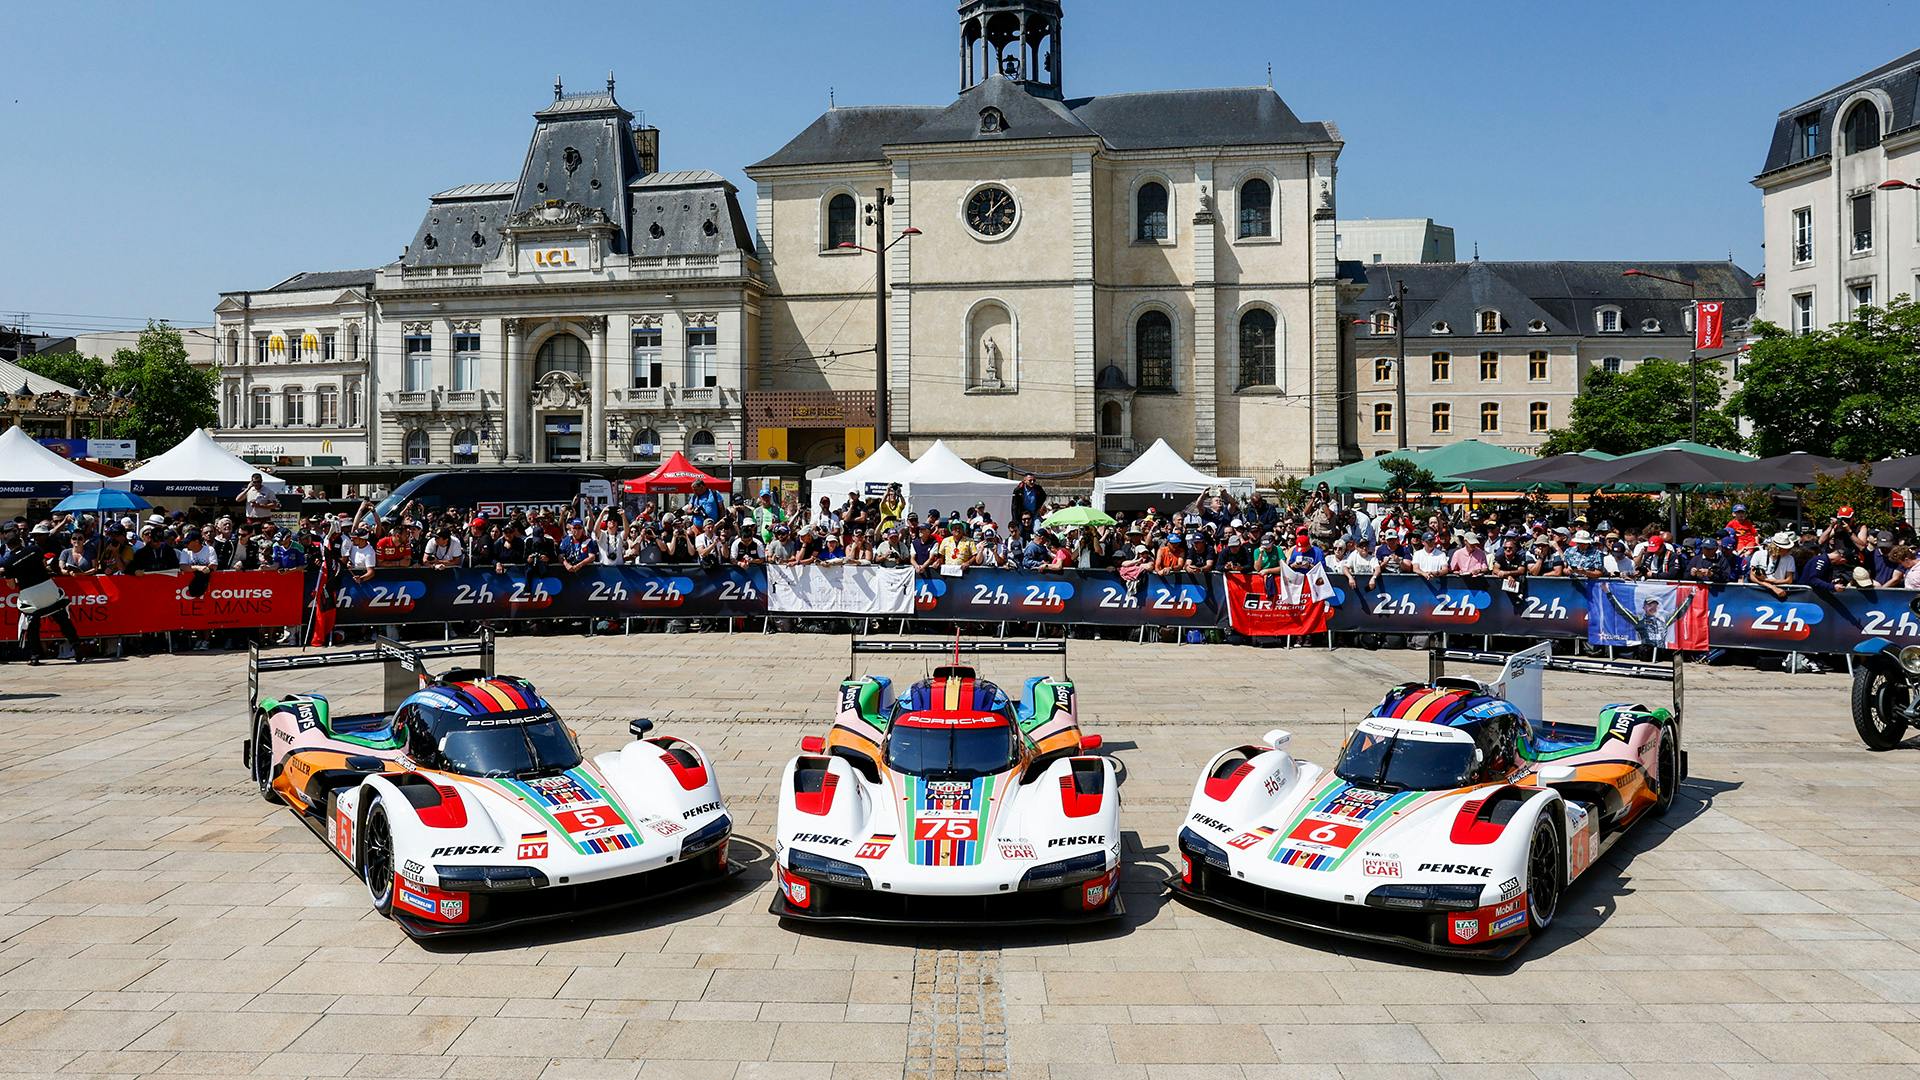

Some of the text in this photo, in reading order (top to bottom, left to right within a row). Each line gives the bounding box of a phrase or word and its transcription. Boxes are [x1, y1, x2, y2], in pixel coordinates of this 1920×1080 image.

[535, 248, 576, 267] LCL
[211, 587, 273, 599] course
[368, 586, 411, 608] 24h
[453, 584, 494, 605] 24h
[588, 581, 628, 601] 24h
[642, 581, 681, 601] 24h
[719, 580, 757, 600] 24h
[971, 584, 1009, 605] 24h
[1023, 585, 1061, 606] 24h
[1153, 588, 1193, 610] 24h
[1244, 600, 1272, 610] GR
[1275, 603, 1307, 611] Racing
[1373, 593, 1417, 615] 24h
[1432, 593, 1476, 616] 24h
[180, 599, 272, 617] LE MANS
[1521, 597, 1568, 619] 24h
[1752, 606, 1807, 631] 24h
[381, 644, 414, 664] PORSCHE
[1511, 650, 1546, 669] PORSCHE
[401, 661, 414, 672] 963
[1056, 686, 1069, 711] Ansys
[467, 712, 554, 726] PORSCHE
[907, 715, 996, 725] PORSCHE
[1610, 714, 1635, 740] Ansys
[274, 728, 295, 745] PENSKE
[1366, 722, 1454, 737] PORSCHE
[682, 801, 720, 820] PENSKE
[1334, 799, 1376, 809] Ansys
[573, 808, 605, 828] 5
[1192, 813, 1234, 834] PENSKE
[657, 823, 684, 835] CAR
[921, 819, 972, 838] 75
[1309, 824, 1338, 842] 6
[792, 833, 853, 846] PENSKE
[1048, 836, 1105, 847] PENSKE
[1233, 834, 1261, 847] HY
[431, 845, 503, 858] PENSKE
[519, 844, 547, 858] HY
[859, 845, 887, 857] HY
[1003, 850, 1033, 858] CAR
[405, 860, 423, 873] BOSS
[1366, 865, 1399, 876] CAR
[1418, 863, 1493, 878] PENSKE
[1088, 887, 1102, 895] TAG
[1500, 878, 1518, 892] BOSS
[1501, 887, 1521, 901] HELLER
[442, 908, 462, 917] HEUER
[1496, 901, 1514, 917] Mobil
[1456, 929, 1478, 938] HEUER
